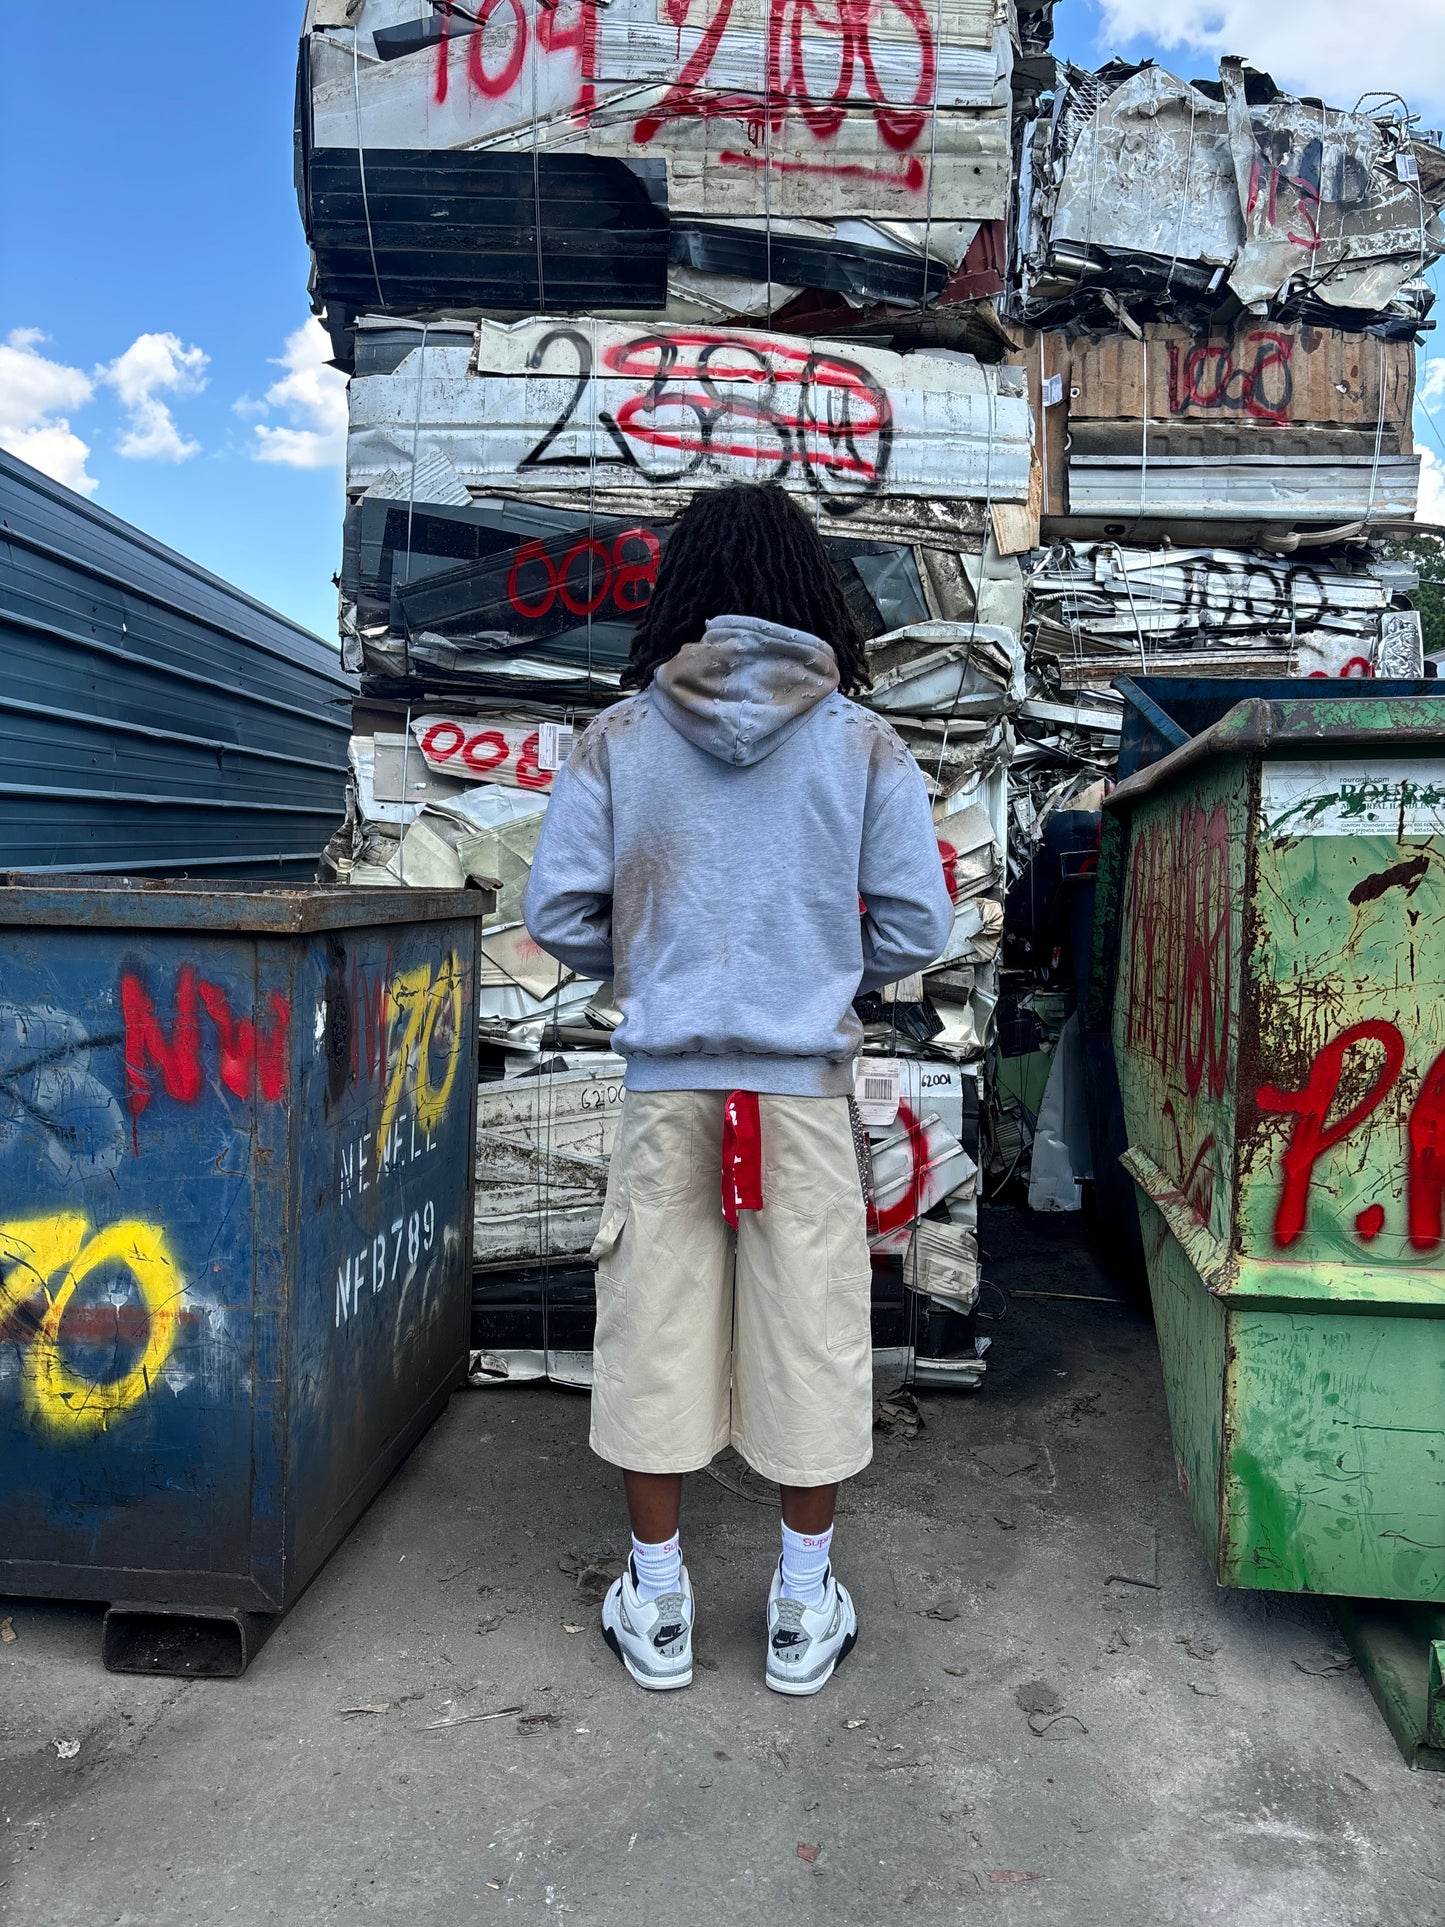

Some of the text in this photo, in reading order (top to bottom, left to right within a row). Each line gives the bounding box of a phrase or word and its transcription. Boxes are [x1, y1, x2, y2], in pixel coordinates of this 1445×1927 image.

[335, 1200, 435, 1329] NFB789
[659, 1644, 684, 1655] AIR
[775, 1650, 800, 1661] AIR
